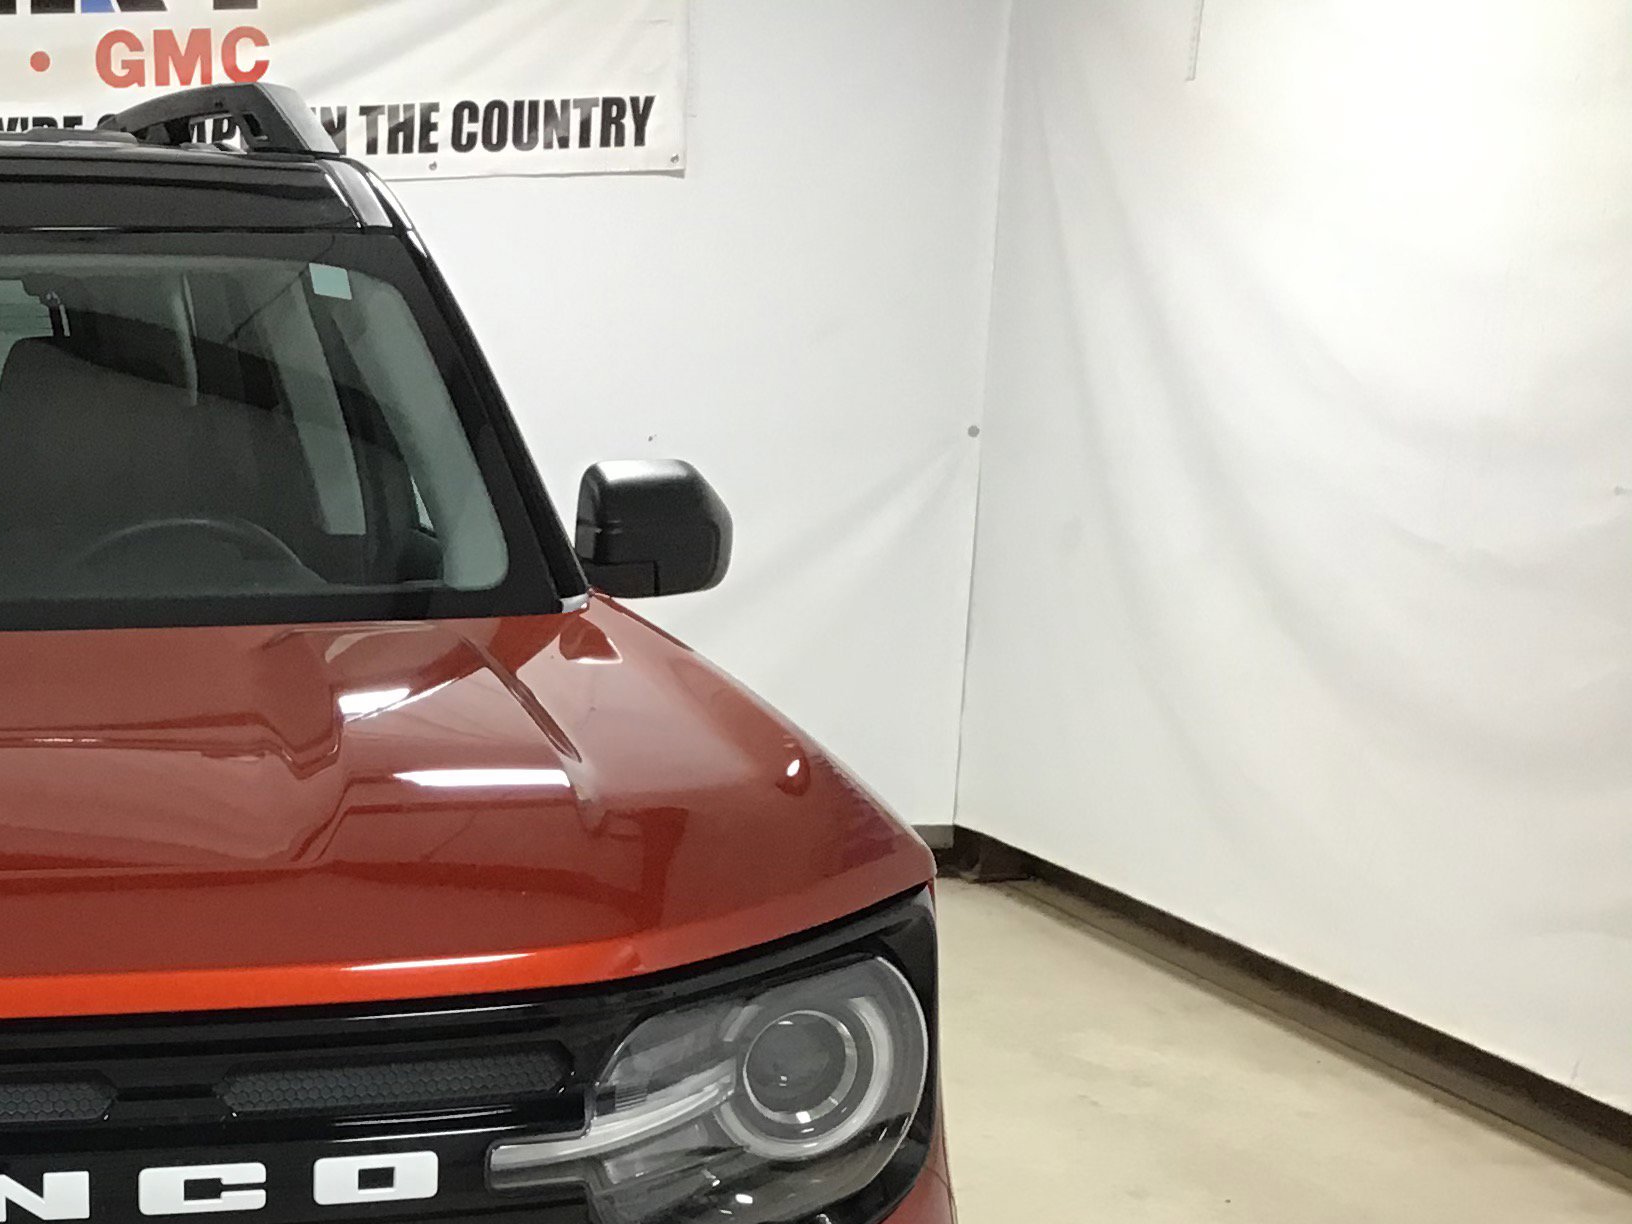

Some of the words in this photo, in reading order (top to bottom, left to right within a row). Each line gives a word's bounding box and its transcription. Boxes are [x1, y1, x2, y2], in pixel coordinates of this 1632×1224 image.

[95, 26, 270, 88] GMC
[359, 102, 439, 155] THE
[451, 95, 656, 153] COUNTRY
